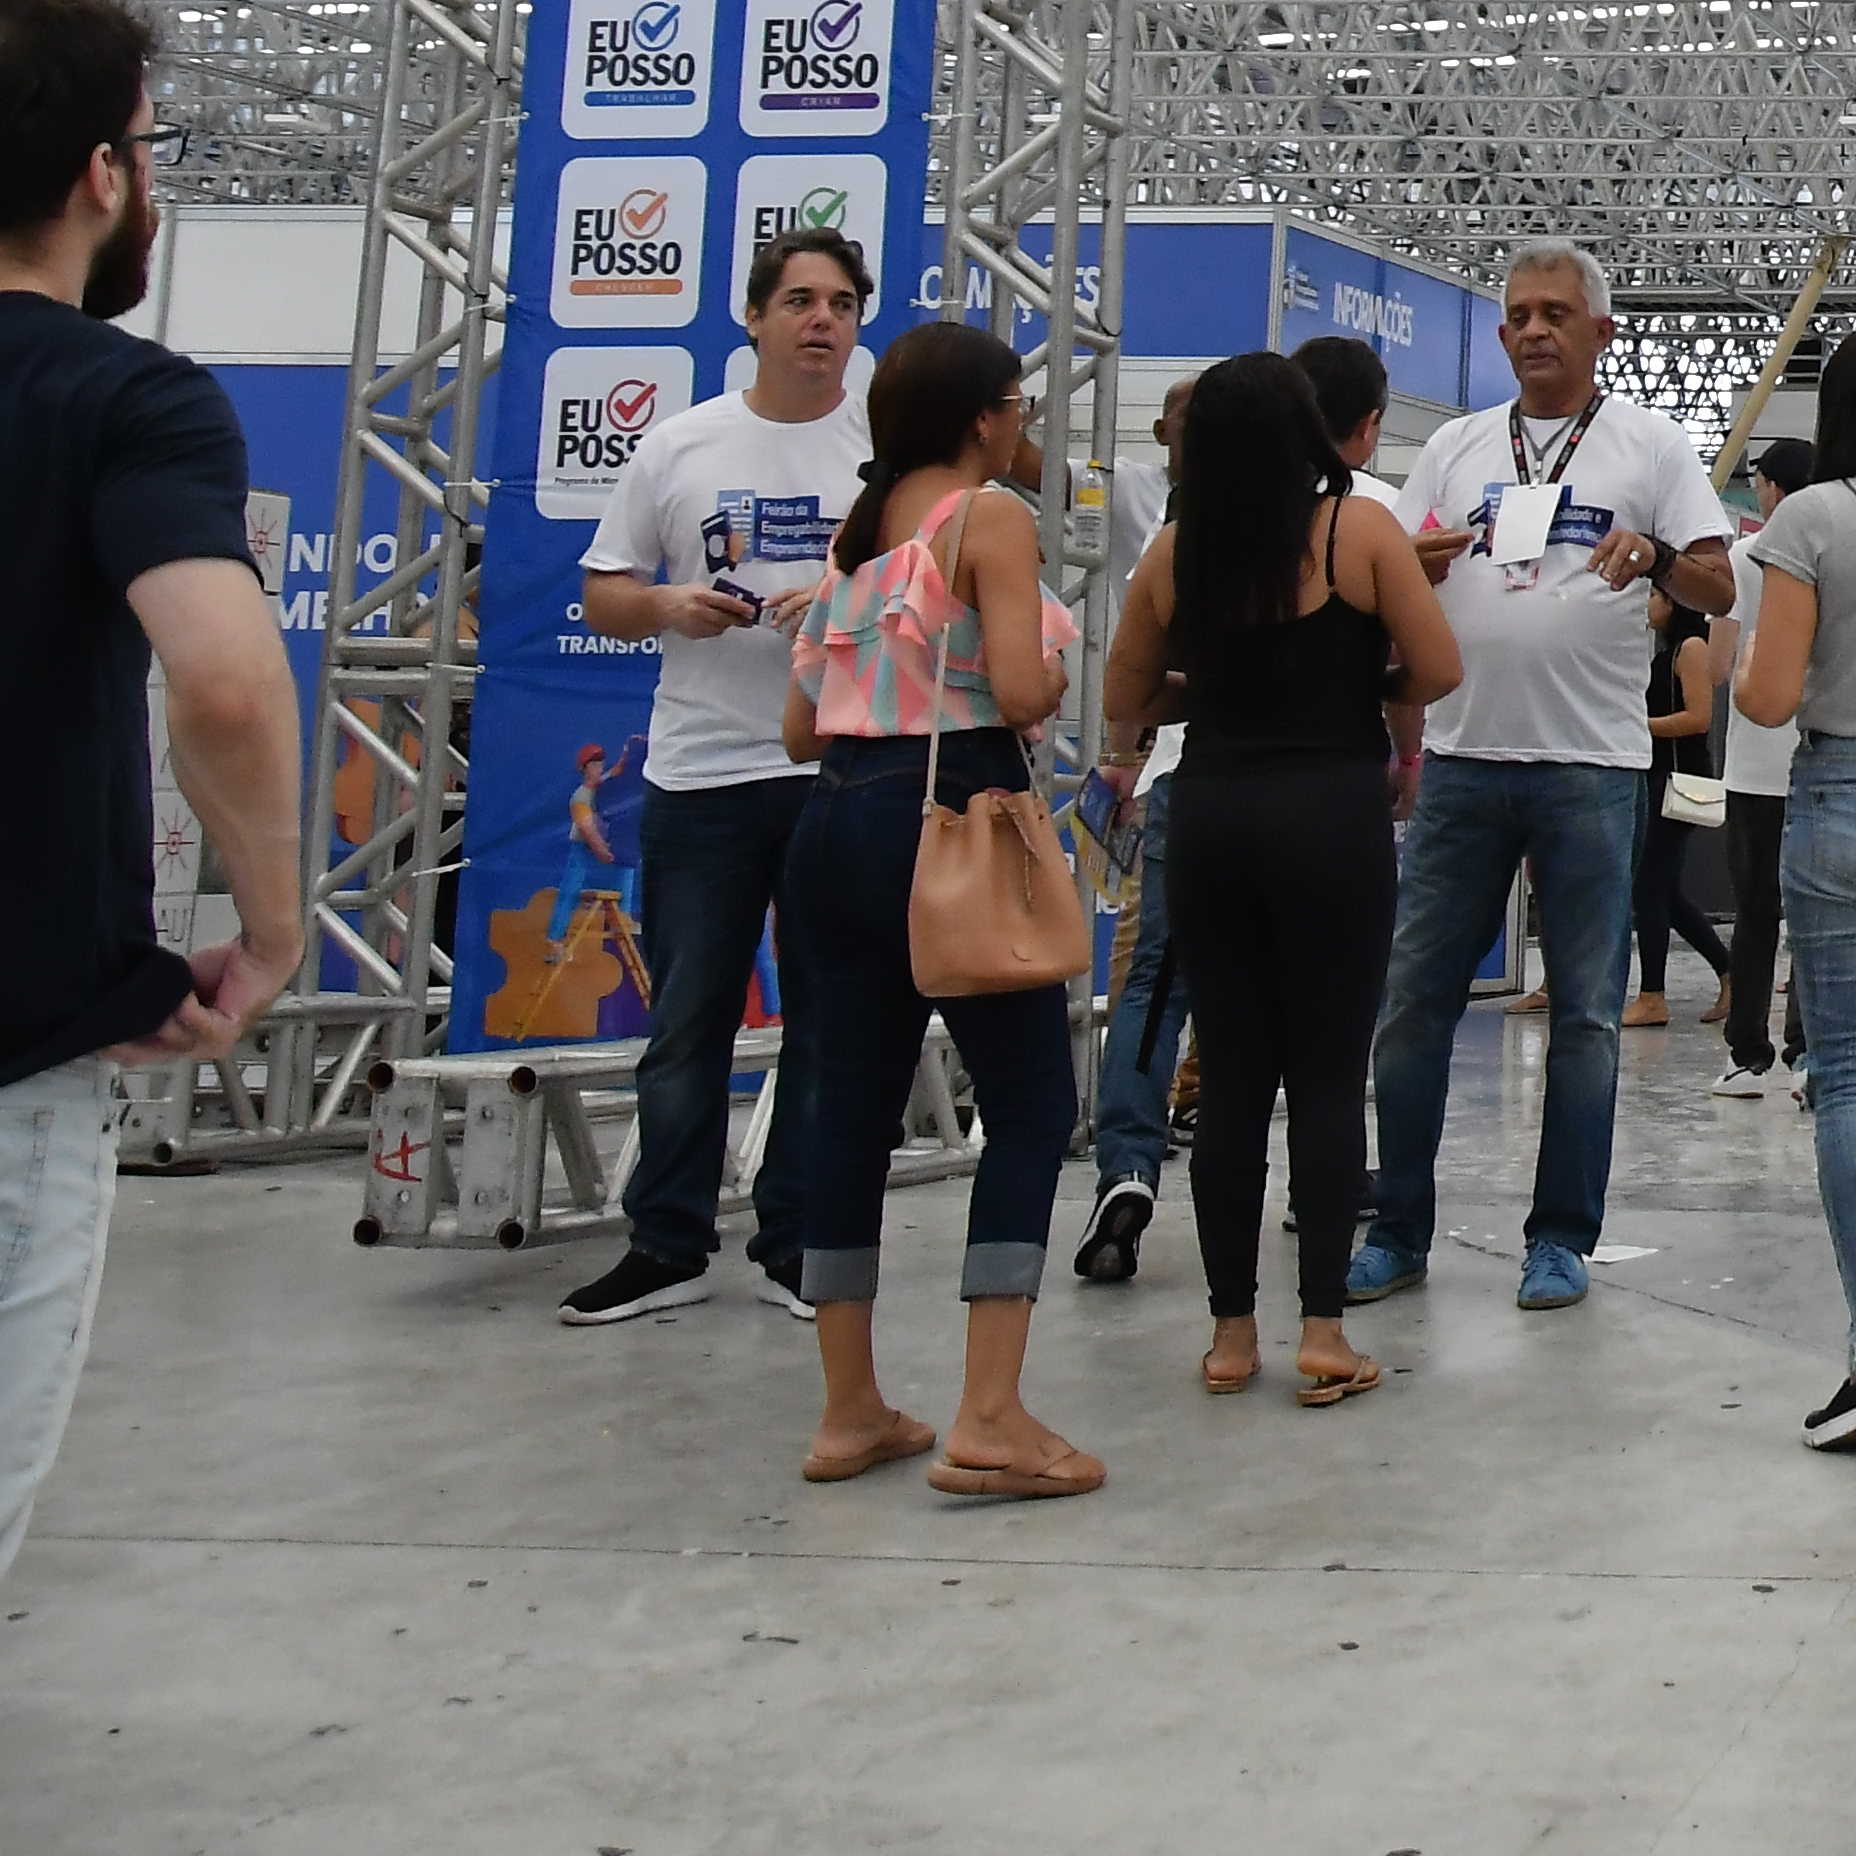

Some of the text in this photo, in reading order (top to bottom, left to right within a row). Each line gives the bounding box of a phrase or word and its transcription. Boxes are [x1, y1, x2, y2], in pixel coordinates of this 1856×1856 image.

[588, 20, 631, 53] EU
[763, 19, 808, 54] EU
[585, 52, 696, 87] POSSO
[761, 53, 879, 90] POSSO
[801, 97, 841, 107] CRIAR
[574, 208, 616, 242] EU
[754, 206, 797, 240] EU
[570, 241, 683, 276] POSSO
[1332, 281, 1413, 353] INFORMAÇÕES
[559, 398, 603, 433] EU
